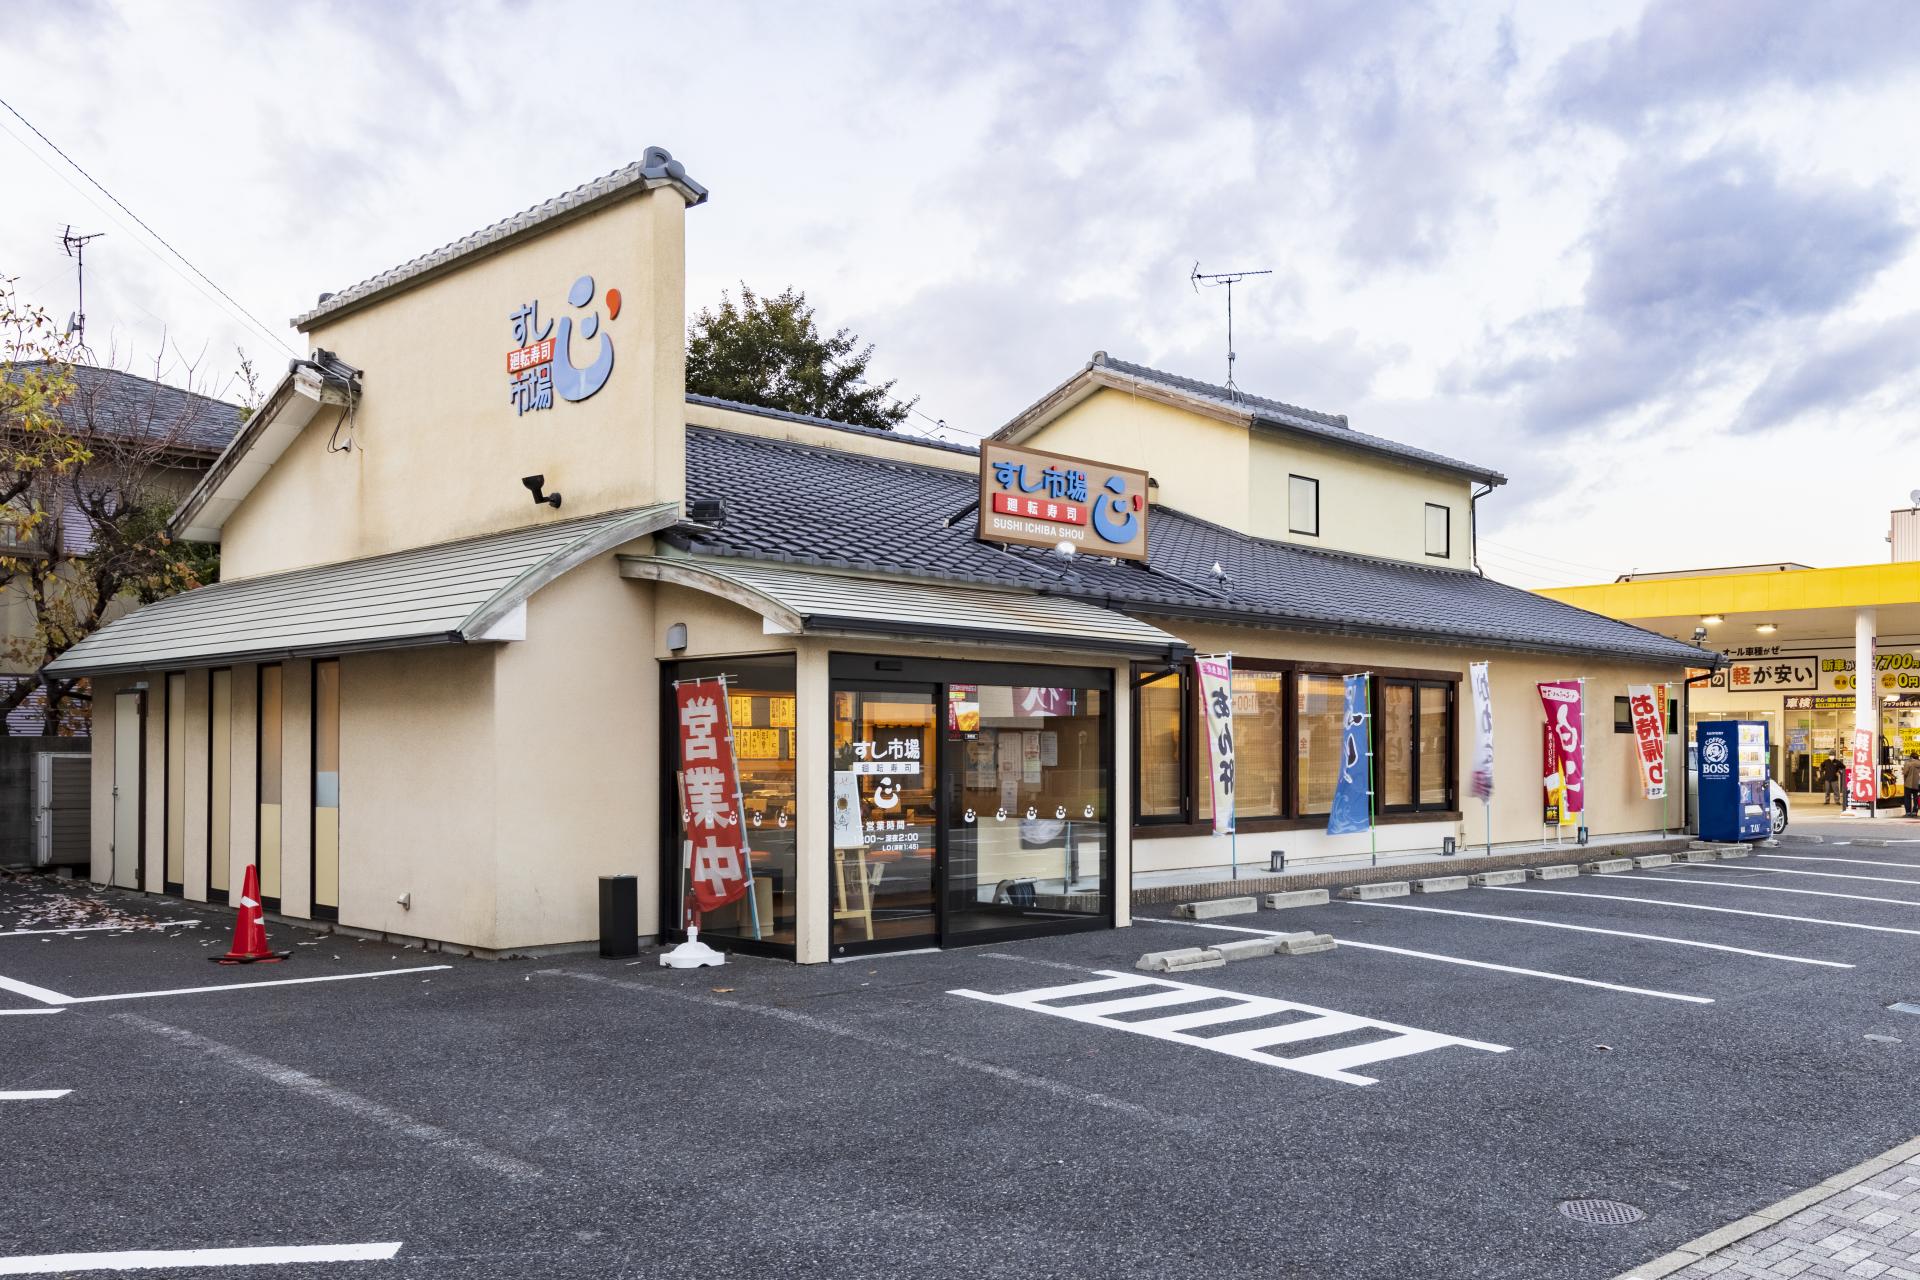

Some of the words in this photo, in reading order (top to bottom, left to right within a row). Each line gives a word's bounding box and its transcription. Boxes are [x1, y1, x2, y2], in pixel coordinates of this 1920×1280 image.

[509, 299, 554, 348] すし
[509, 363, 553, 416] 市場
[992, 461, 1089, 503] すし市場
[993, 518, 1023, 532] SUSHI
[1025, 522, 1056, 536] ICHIBA
[1059, 527, 1085, 540] SHOU
[1732, 664, 1812, 685] 軽が安い
[1898, 673, 1919, 688] 0円
[853, 738, 921, 760] すし市場
[1704, 737, 1727, 746] COFFEE
[1702, 763, 1730, 774] BOSS
[1855, 733, 1873, 798] 軽が安い
[681, 696, 743, 897] 営業中
